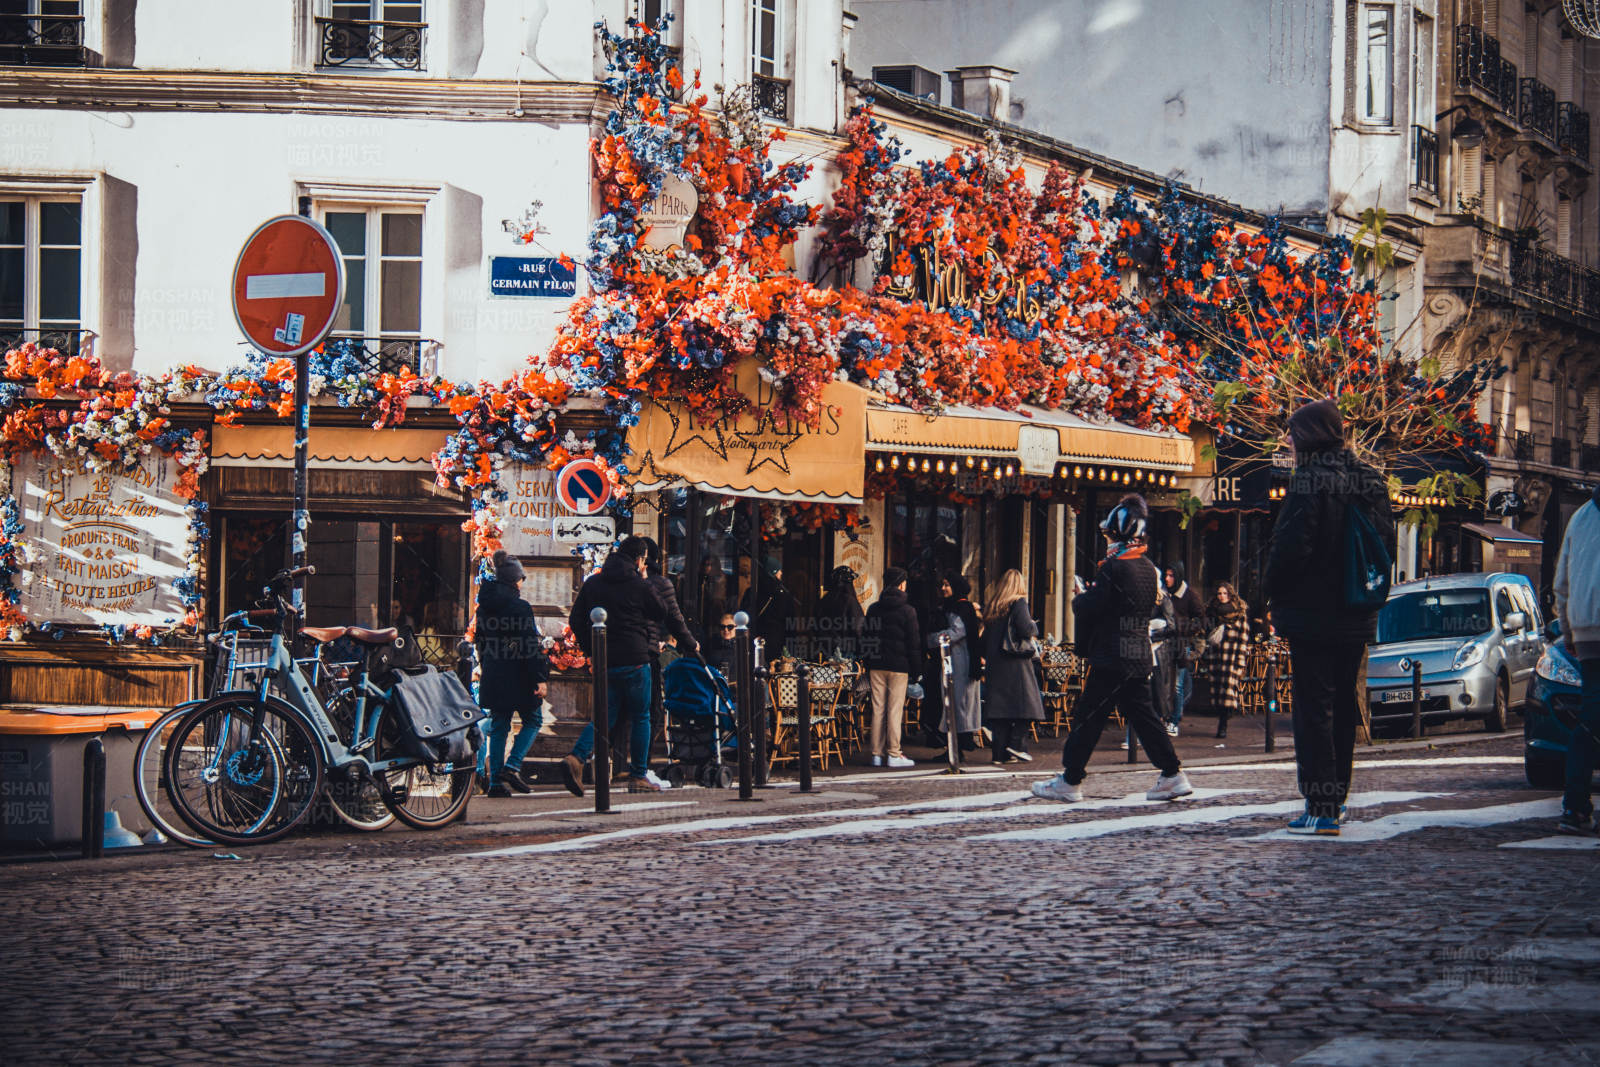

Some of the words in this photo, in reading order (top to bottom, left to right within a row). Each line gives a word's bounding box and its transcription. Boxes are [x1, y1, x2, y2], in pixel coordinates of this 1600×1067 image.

[661, 194, 689, 216] PARIS
[522, 263, 546, 273] RUE
[492, 279, 540, 289] GERMAIN
[543, 280, 575, 290] PILON
[92, 476, 110, 492] 18
[515, 481, 557, 498] SERVI
[44, 490, 160, 521] Restauration
[60, 530, 110, 548] PRODUITS
[112, 531, 140, 553] FRAIS
[59, 554, 86, 578] FAIT
[88, 557, 139, 579] MAISON
[53, 579, 105, 598] TOUTE
[107, 576, 156, 597] HEURE
